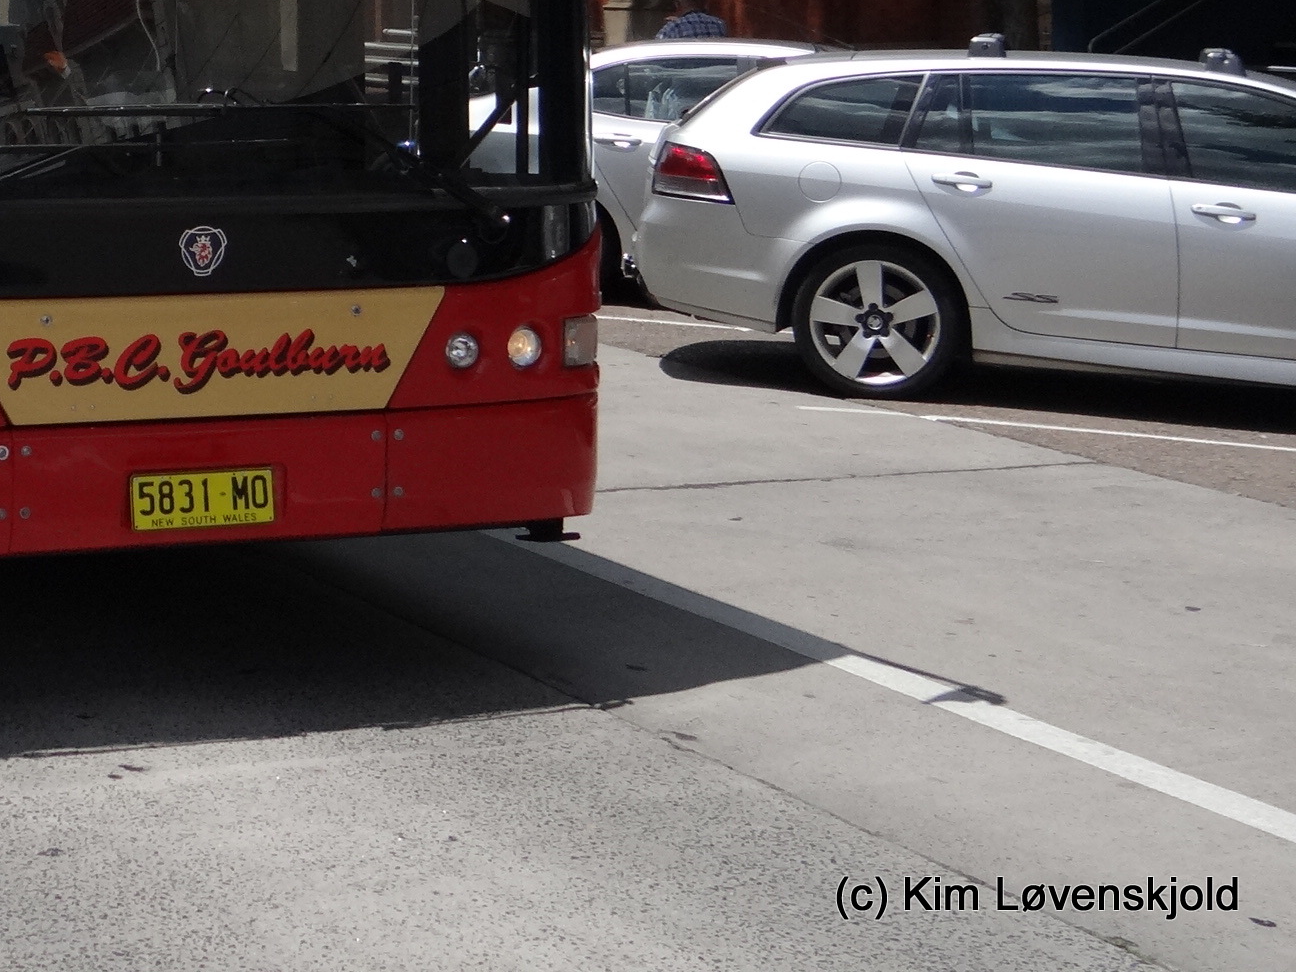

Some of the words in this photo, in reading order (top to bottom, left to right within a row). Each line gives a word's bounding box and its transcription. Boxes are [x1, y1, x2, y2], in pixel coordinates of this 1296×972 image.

[173, 329, 392, 395] Goulburn
[138, 477, 210, 516] 5831
[231, 474, 269, 511] MO
[151, 517, 175, 527] NEW
[181, 515, 217, 526] SOUTH
[223, 512, 258, 523] WALES
